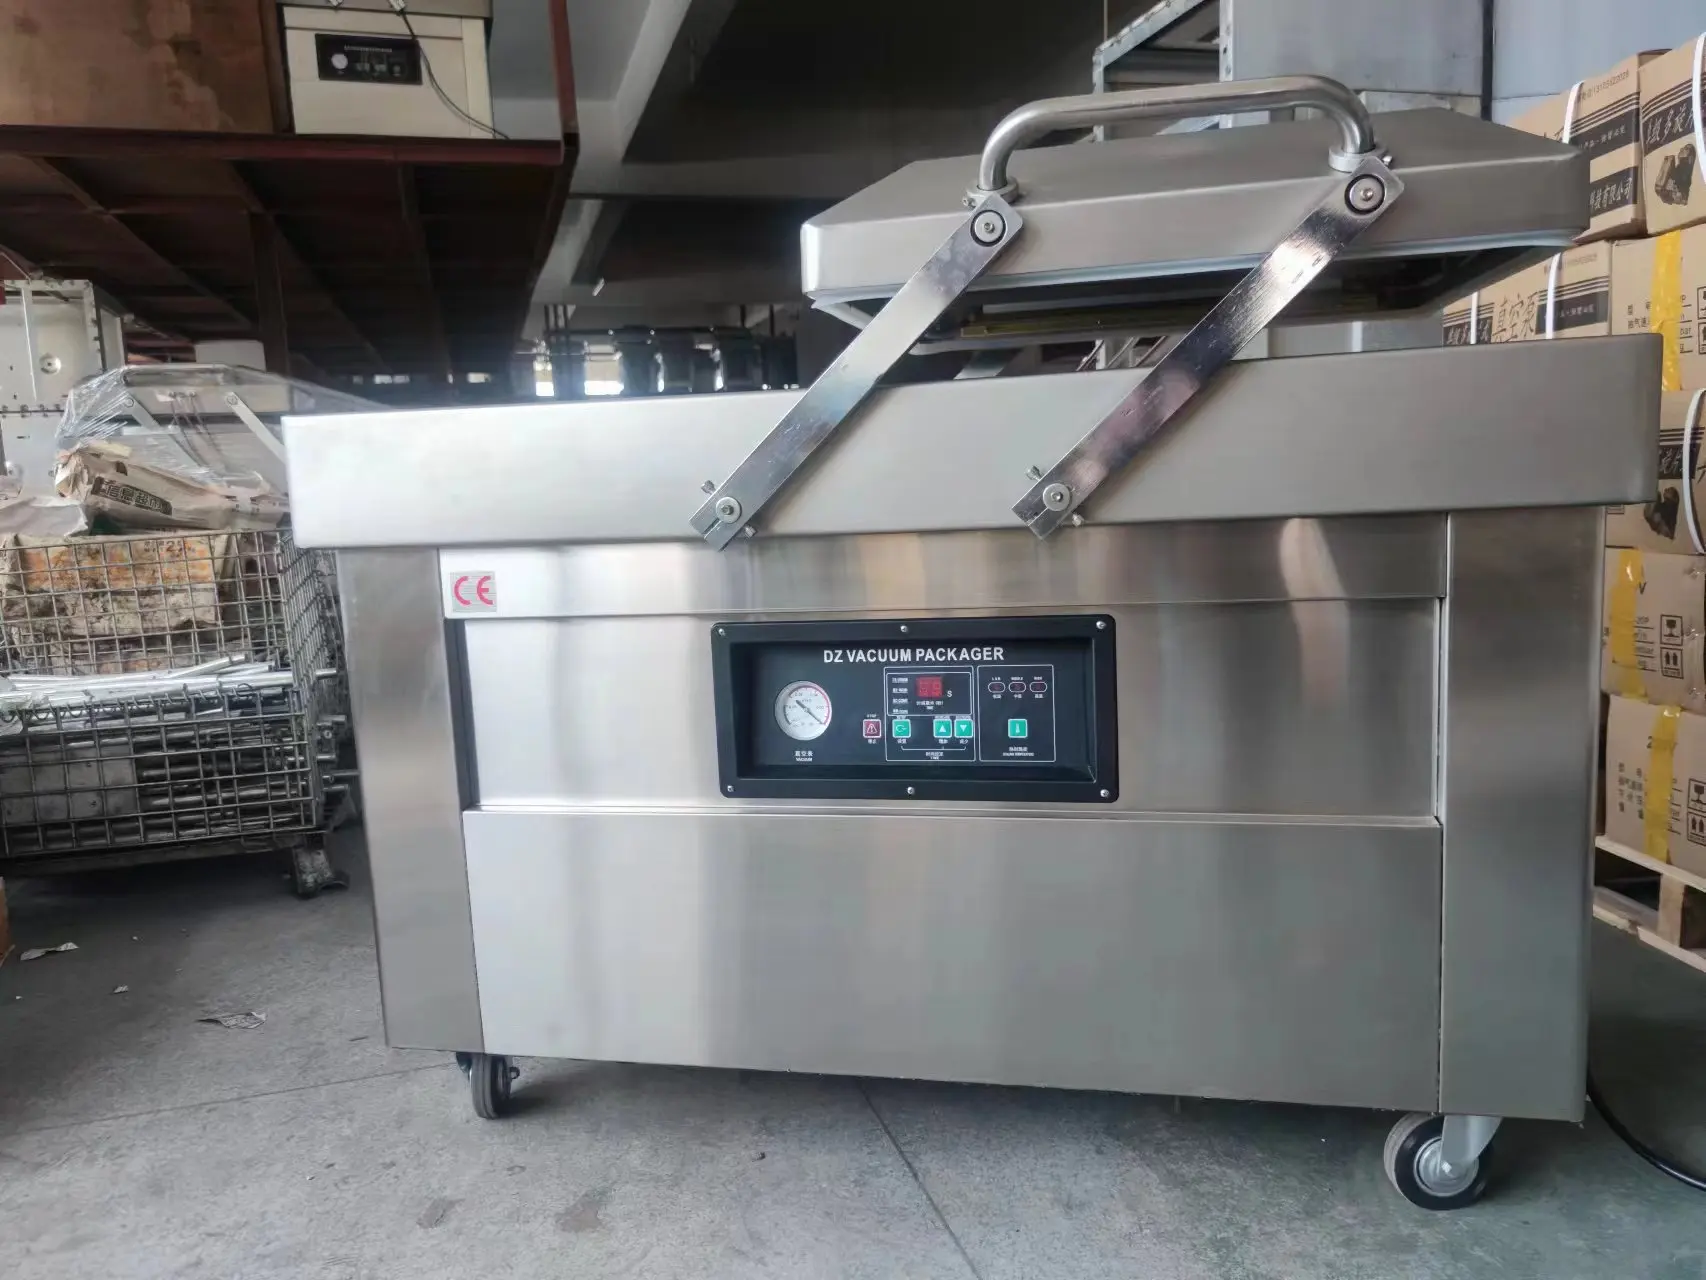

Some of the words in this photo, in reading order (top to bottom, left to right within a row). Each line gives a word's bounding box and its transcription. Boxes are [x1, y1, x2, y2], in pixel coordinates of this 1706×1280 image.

[454, 575, 494, 605] CE
[823, 649, 844, 663] DZ
[846, 648, 912, 663] VACUUM
[915, 646, 1005, 662] PACKAGER
